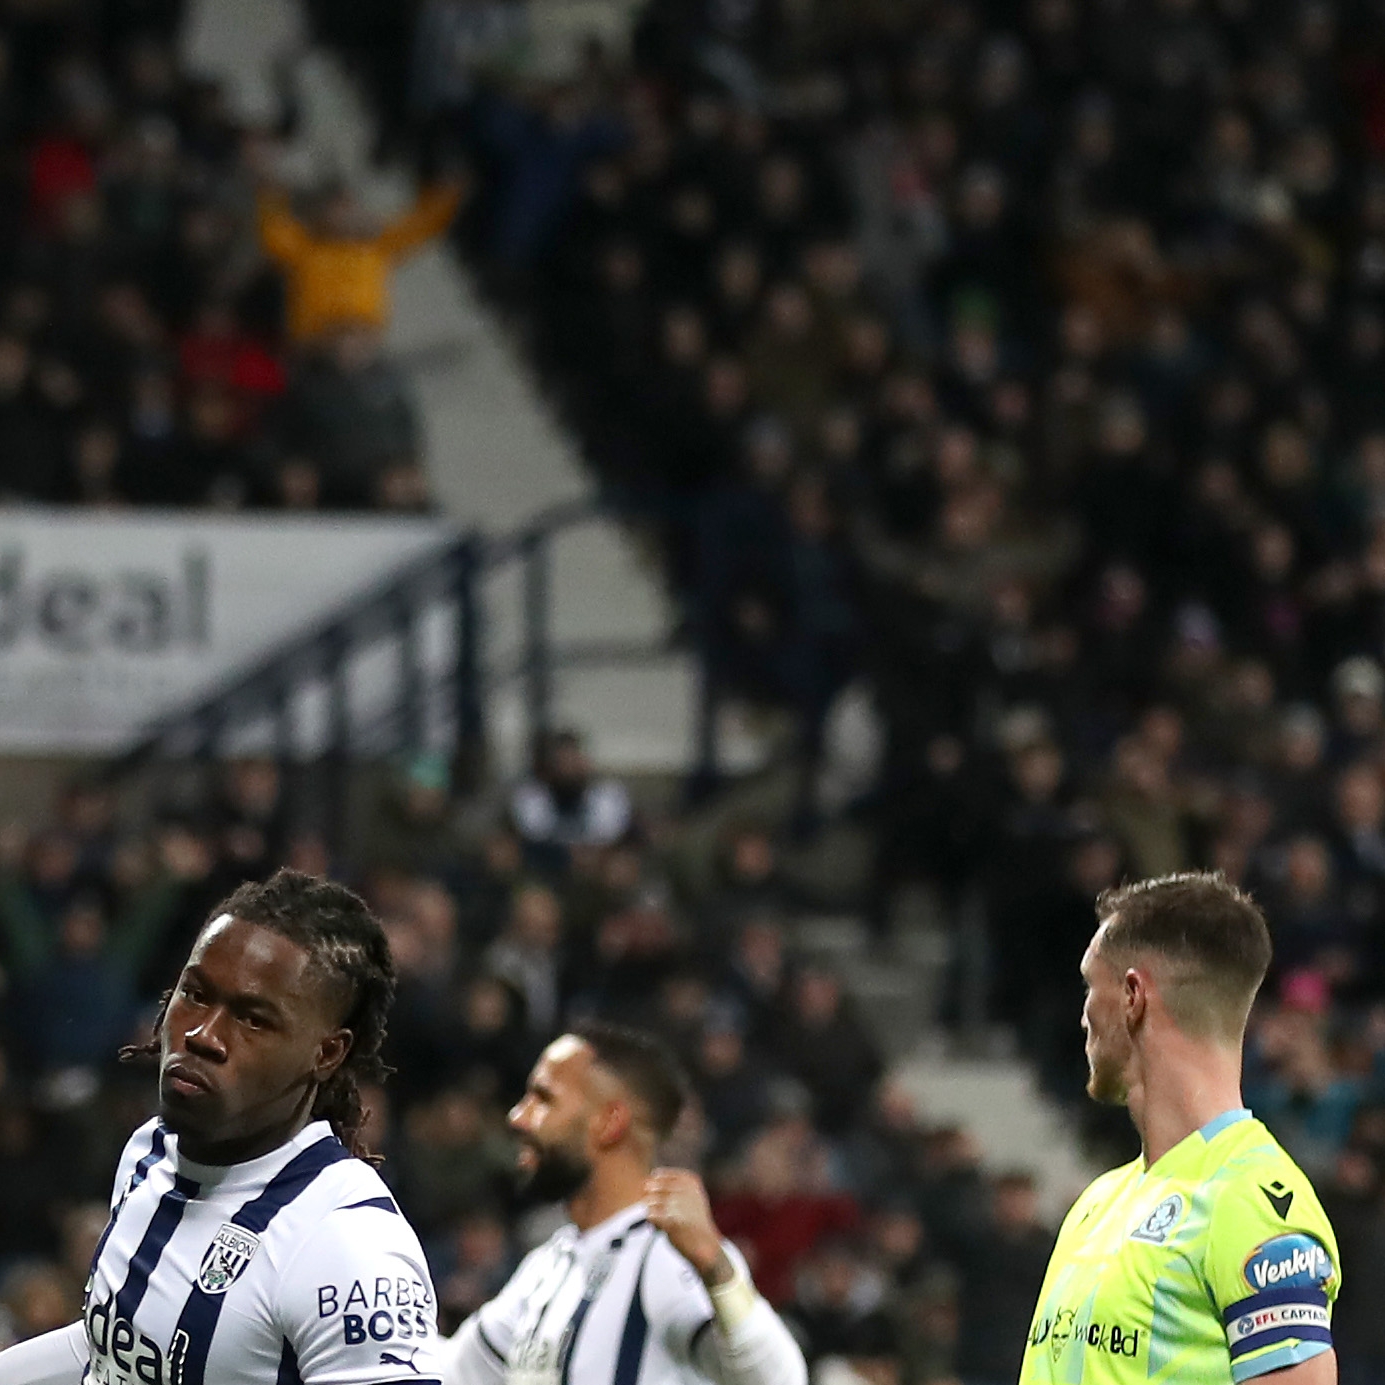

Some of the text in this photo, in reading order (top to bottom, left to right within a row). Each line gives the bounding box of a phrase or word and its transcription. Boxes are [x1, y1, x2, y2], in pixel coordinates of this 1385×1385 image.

[216, 1233, 255, 1257] ALBION
[318, 1276, 431, 1318] BARBE
[343, 1309, 428, 1345] BOSS
[1255, 1312, 1278, 1326] EFL
